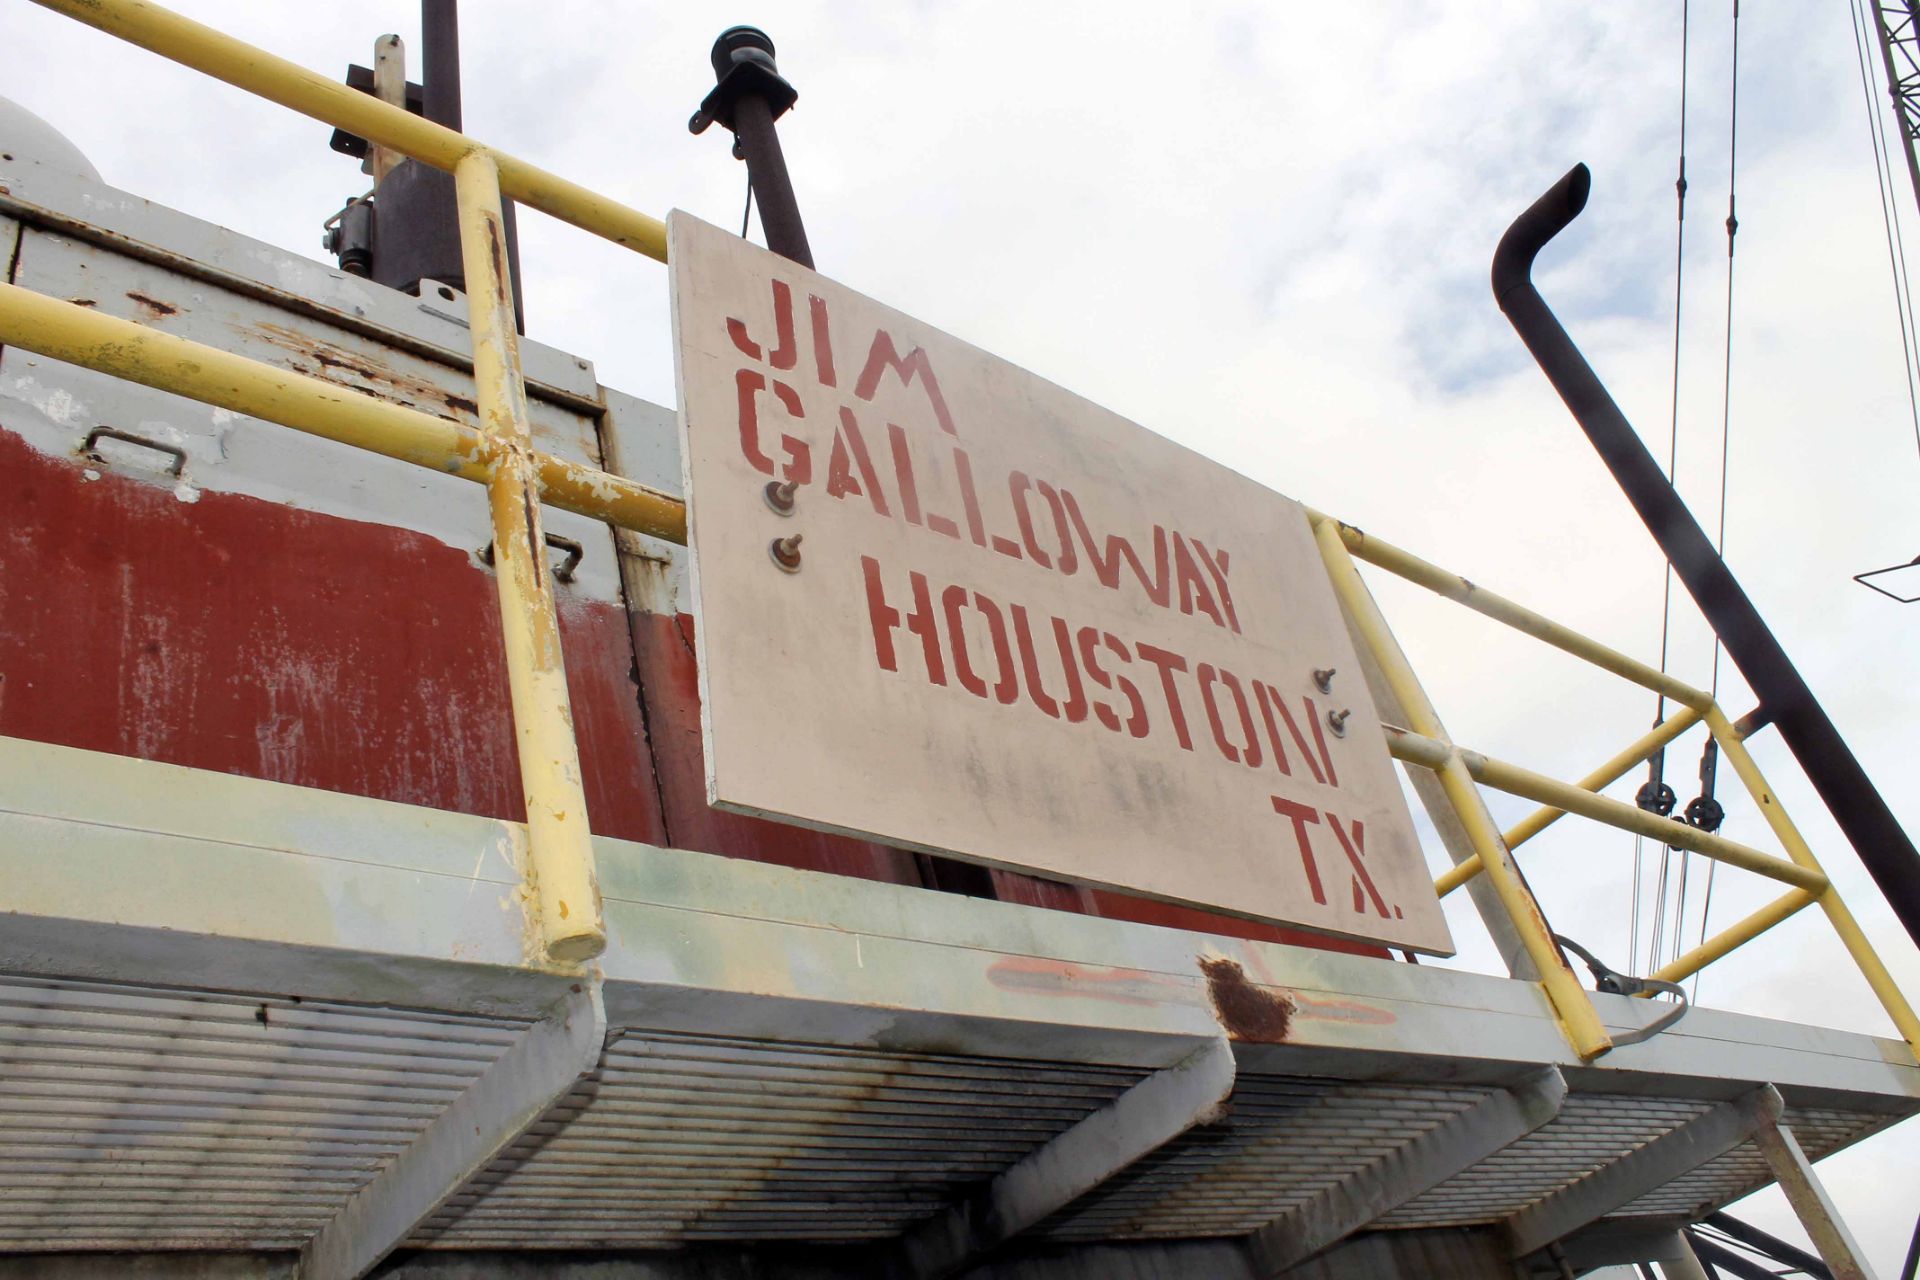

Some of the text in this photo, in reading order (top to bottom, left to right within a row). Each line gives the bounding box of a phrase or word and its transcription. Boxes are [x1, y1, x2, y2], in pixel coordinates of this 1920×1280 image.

[727, 278, 958, 436] JIM
[735, 368, 1242, 634] GALLOWAY
[861, 555, 1339, 788] HOUSTON
[1270, 795, 1404, 921] TX.
